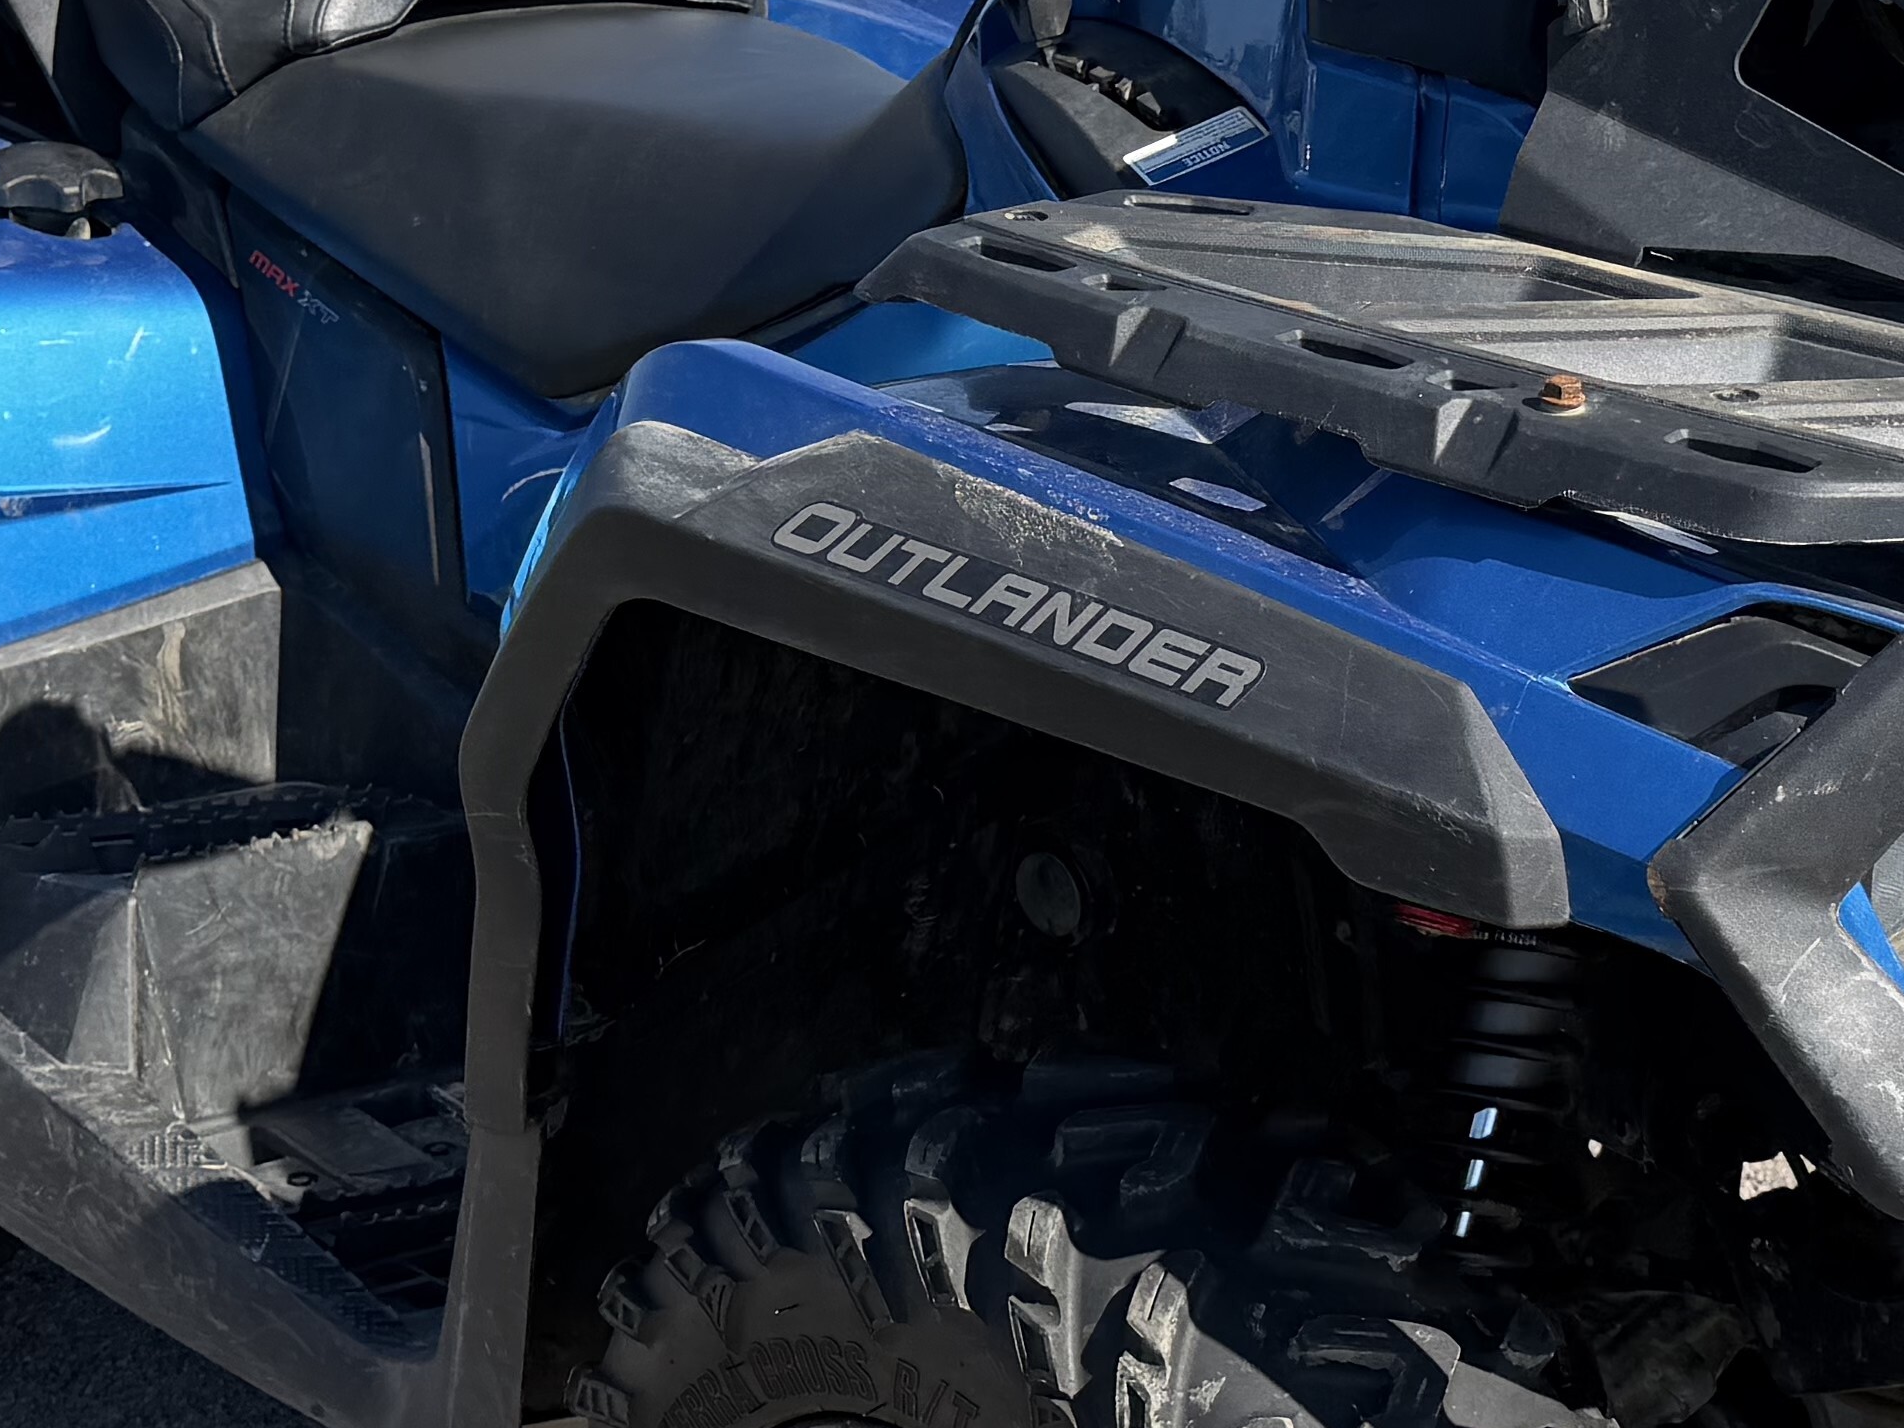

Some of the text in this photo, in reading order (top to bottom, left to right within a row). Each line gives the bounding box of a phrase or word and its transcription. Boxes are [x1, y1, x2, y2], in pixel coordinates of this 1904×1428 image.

[1181, 139, 1231, 168] NOTICE
[248, 249, 340, 325] MAX XT
[772, 502, 1266, 708] OUTLANDER
